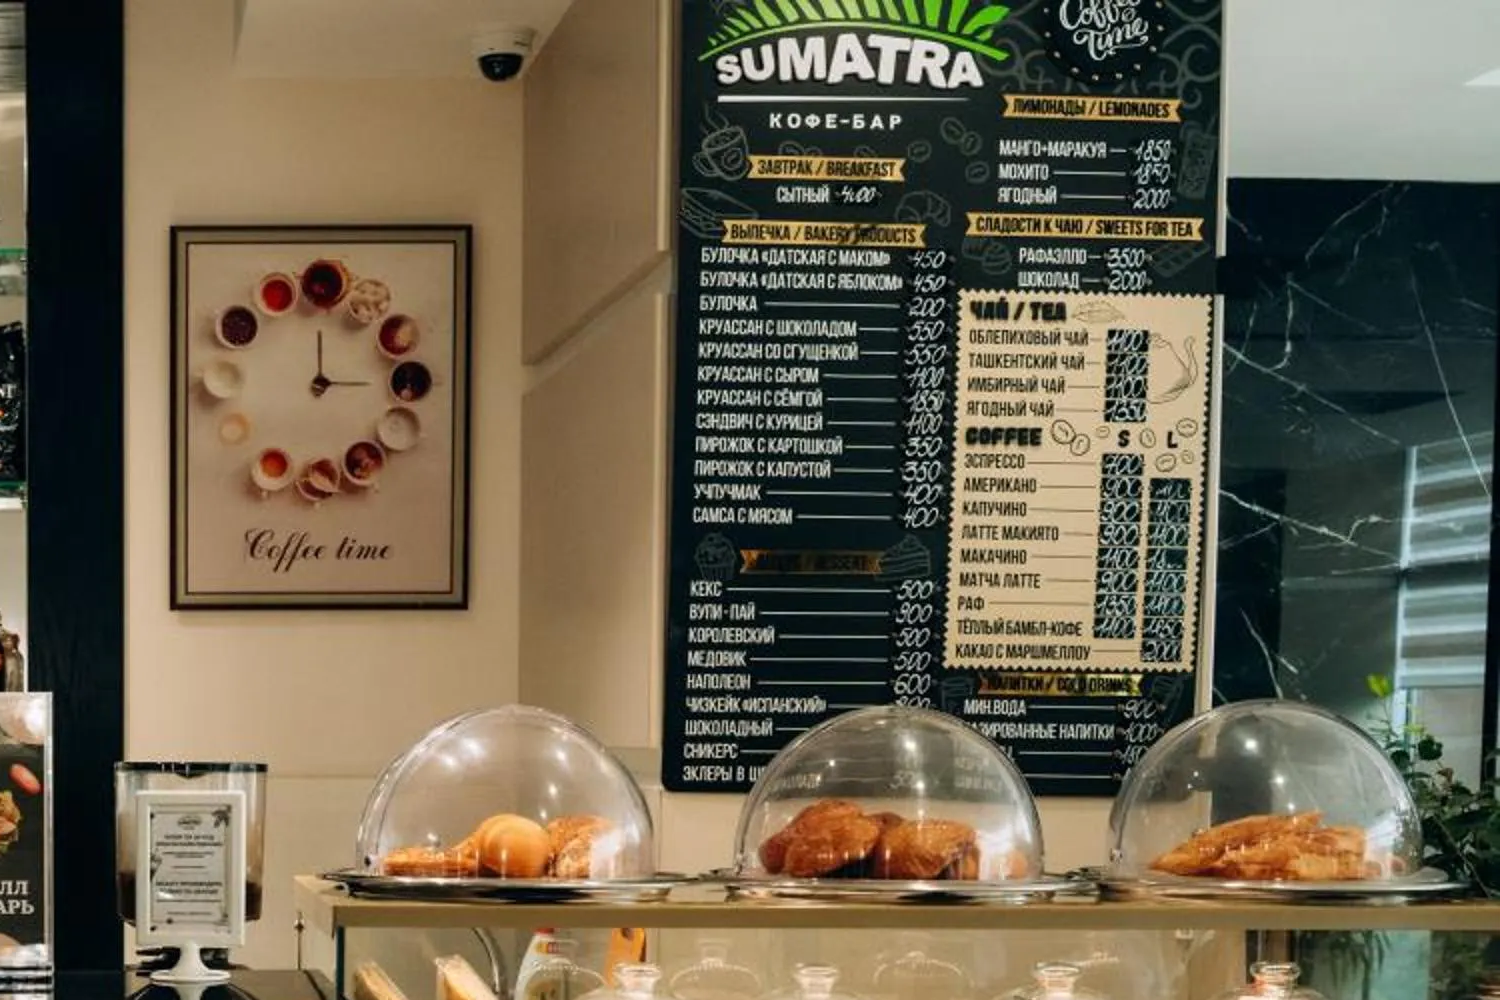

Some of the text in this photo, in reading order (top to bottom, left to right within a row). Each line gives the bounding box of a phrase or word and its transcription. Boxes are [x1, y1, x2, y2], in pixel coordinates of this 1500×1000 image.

[1073, 17, 1150, 61] Time
[715, 32, 985, 89] SUMATRA
[1012, 98, 1170, 118] ЛИМОНАДЫ LEMONADES
[769, 112, 903, 131] КОФЕ-БАР
[999, 139, 1107, 158] МАНГО+МАРАКУЯ
[757, 158, 897, 177] ЗАВТРАК BREAKFAST
[998, 163, 1049, 181] МОХИТО
[776, 185, 831, 203] СЫТНЫЙ
[998, 185, 1057, 204] ЯГОДНЫЙ
[730, 223, 791, 241] ВЫПЕЧКА
[975, 216, 1193, 236] СЛАДОСТИ К ЧАЮ SWEETS FOR TEA
[701, 247, 759, 264] БУЛОЧКА
[761, 248, 826, 266] «ДАТСКАЯ
[827, 250, 836, 266] С
[838, 250, 891, 267] МАКОМ»
[1019, 247, 1088, 265] РАФАЭЛЛО
[700, 271, 758, 288] БУЛОЧКА
[761, 272, 825, 290] «ДАТСКАЯ
[827, 273, 836, 289] С
[838, 273, 904, 291] ЯБЛОКОМ»
[1018, 272, 1080, 290] ШОКОЛАД
[700, 295, 945, 317] БУЛОЧКА 200
[699, 318, 764, 335] КРУАССАН
[765, 320, 774, 335] С
[776, 320, 857, 338] ШОКОЛАДОМ
[969, 327, 1061, 345] ОБЛЕПИХОВЫЙ
[1064, 328, 1089, 345] ЧАЙ
[698, 342, 763, 360] КРУАССАН
[766, 343, 785, 360] СО
[785, 341, 860, 361] СГУЩЕНКОЙ
[969, 351, 1085, 371] ТАШКЕНТСКИЙ ЧАЙ
[698, 366, 763, 383] КРУАССАН
[764, 366, 774, 383] С
[775, 367, 819, 384] СЫРОМ
[967, 375, 1037, 394] ИМБИРНЫЙ
[1041, 376, 1066, 395] ЧАЙ
[697, 388, 823, 407] КРУАССАН С СЁМГОЙ
[966, 398, 1054, 417] ЯГОДНЫЙ ЧАЙ
[696, 413, 752, 431] СЭНДВИЧ
[755, 414, 765, 430] С
[766, 412, 823, 431] КУРИЦЕЙ
[695, 436, 755, 453] ПИРОЖОК
[757, 437, 767, 453] С
[768, 435, 843, 455] КАРТОШКОЙ
[965, 426, 1178, 448] COFFEE S L
[694, 459, 753, 477] ПИРОЖОК
[756, 460, 765, 477] С
[766, 459, 831, 478] КАПУСТОЙ
[964, 453, 1025, 469] ЭСПРЕССО
[693, 483, 762, 501] УЧПУЧМАК
[963, 477, 1037, 493] АМЕРИКАНО
[693, 506, 736, 524] САМСА
[738, 507, 747, 523] С
[748, 507, 793, 525] МЯСОМ
[962, 501, 1027, 517] КАПУЧИНО
[962, 524, 999, 541] ЛАТТЕ
[1001, 524, 1059, 541] МАКИЯТО
[244, 527, 394, 573] Coffee time
[959, 548, 1027, 565] МАКАЧИНО
[690, 580, 934, 600] КЕКС 500
[959, 572, 1001, 589] МАТЧА
[1003, 572, 1041, 589] ЛАТТЕ
[957, 595, 985, 611] РАФ
[957, 617, 1083, 637] ТЁПЛЫЙ БАМБЛ-КОФЕ
[688, 626, 931, 648] КОРОЛЕВСКИЙ 500
[687, 650, 747, 668] МЕДОВИК
[955, 643, 1091, 660] КАКАО С МАРШМЕЛЛОУ
[687, 673, 751, 689] НАПОЛЕОН
[686, 694, 741, 713] ЧИЗКЕЙК
[685, 719, 773, 737] ШОКОЛАДНЫЙ
[966, 722, 1057, 739] АЗИРОВАННЫЕ
[1059, 723, 1115, 740] НАПИТКИ
[683, 743, 739, 760] СНИКЕРС
[682, 765, 732, 782] ЭКЛЕРЫ
[736, 766, 745, 781] В
